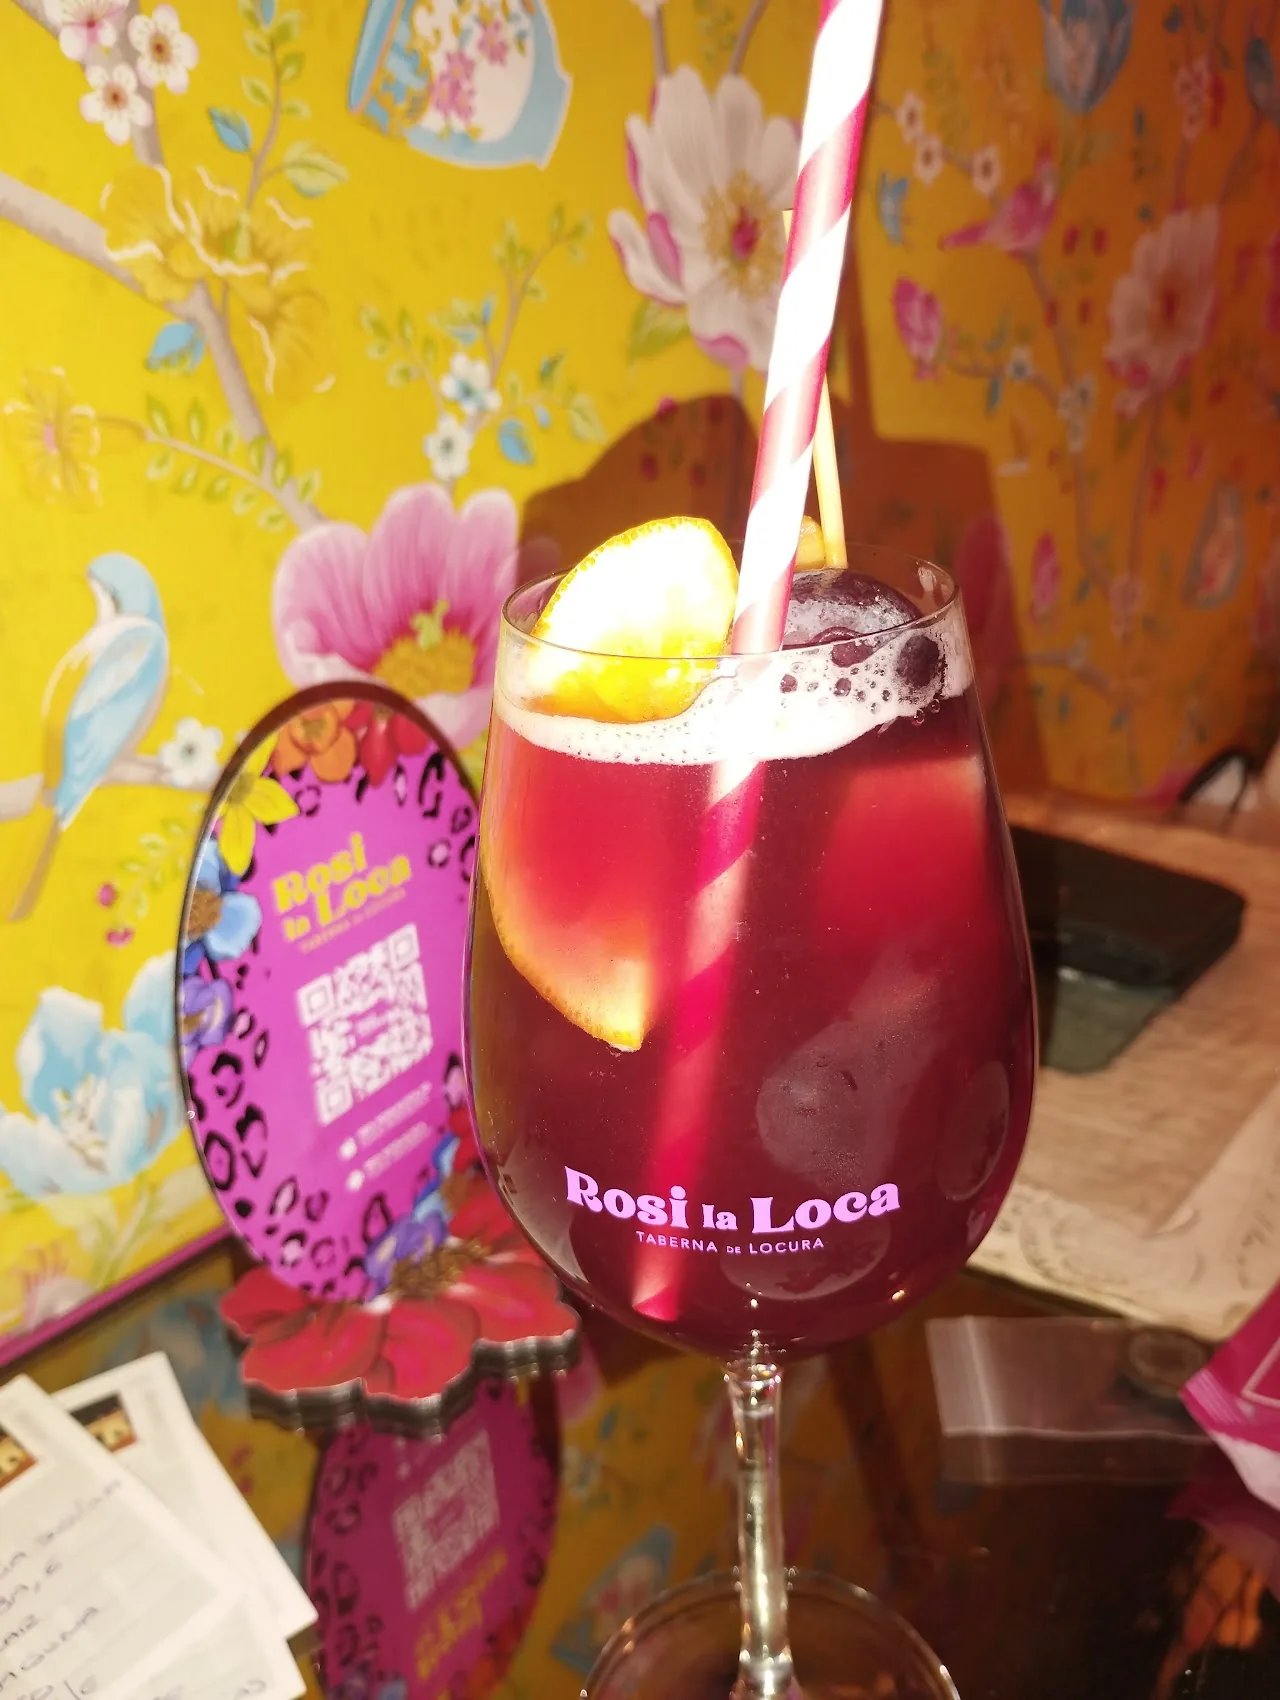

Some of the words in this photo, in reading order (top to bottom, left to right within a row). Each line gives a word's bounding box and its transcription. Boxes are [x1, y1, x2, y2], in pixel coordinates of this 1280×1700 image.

[564, 1165, 689, 1229] Rosi
[702, 1203, 738, 1230] la
[750, 1183, 900, 1234] Loca
[635, 1230, 718, 1253] TABERNA
[726, 1245, 742, 1255] DE
[749, 1237, 825, 1254] LOCURA
